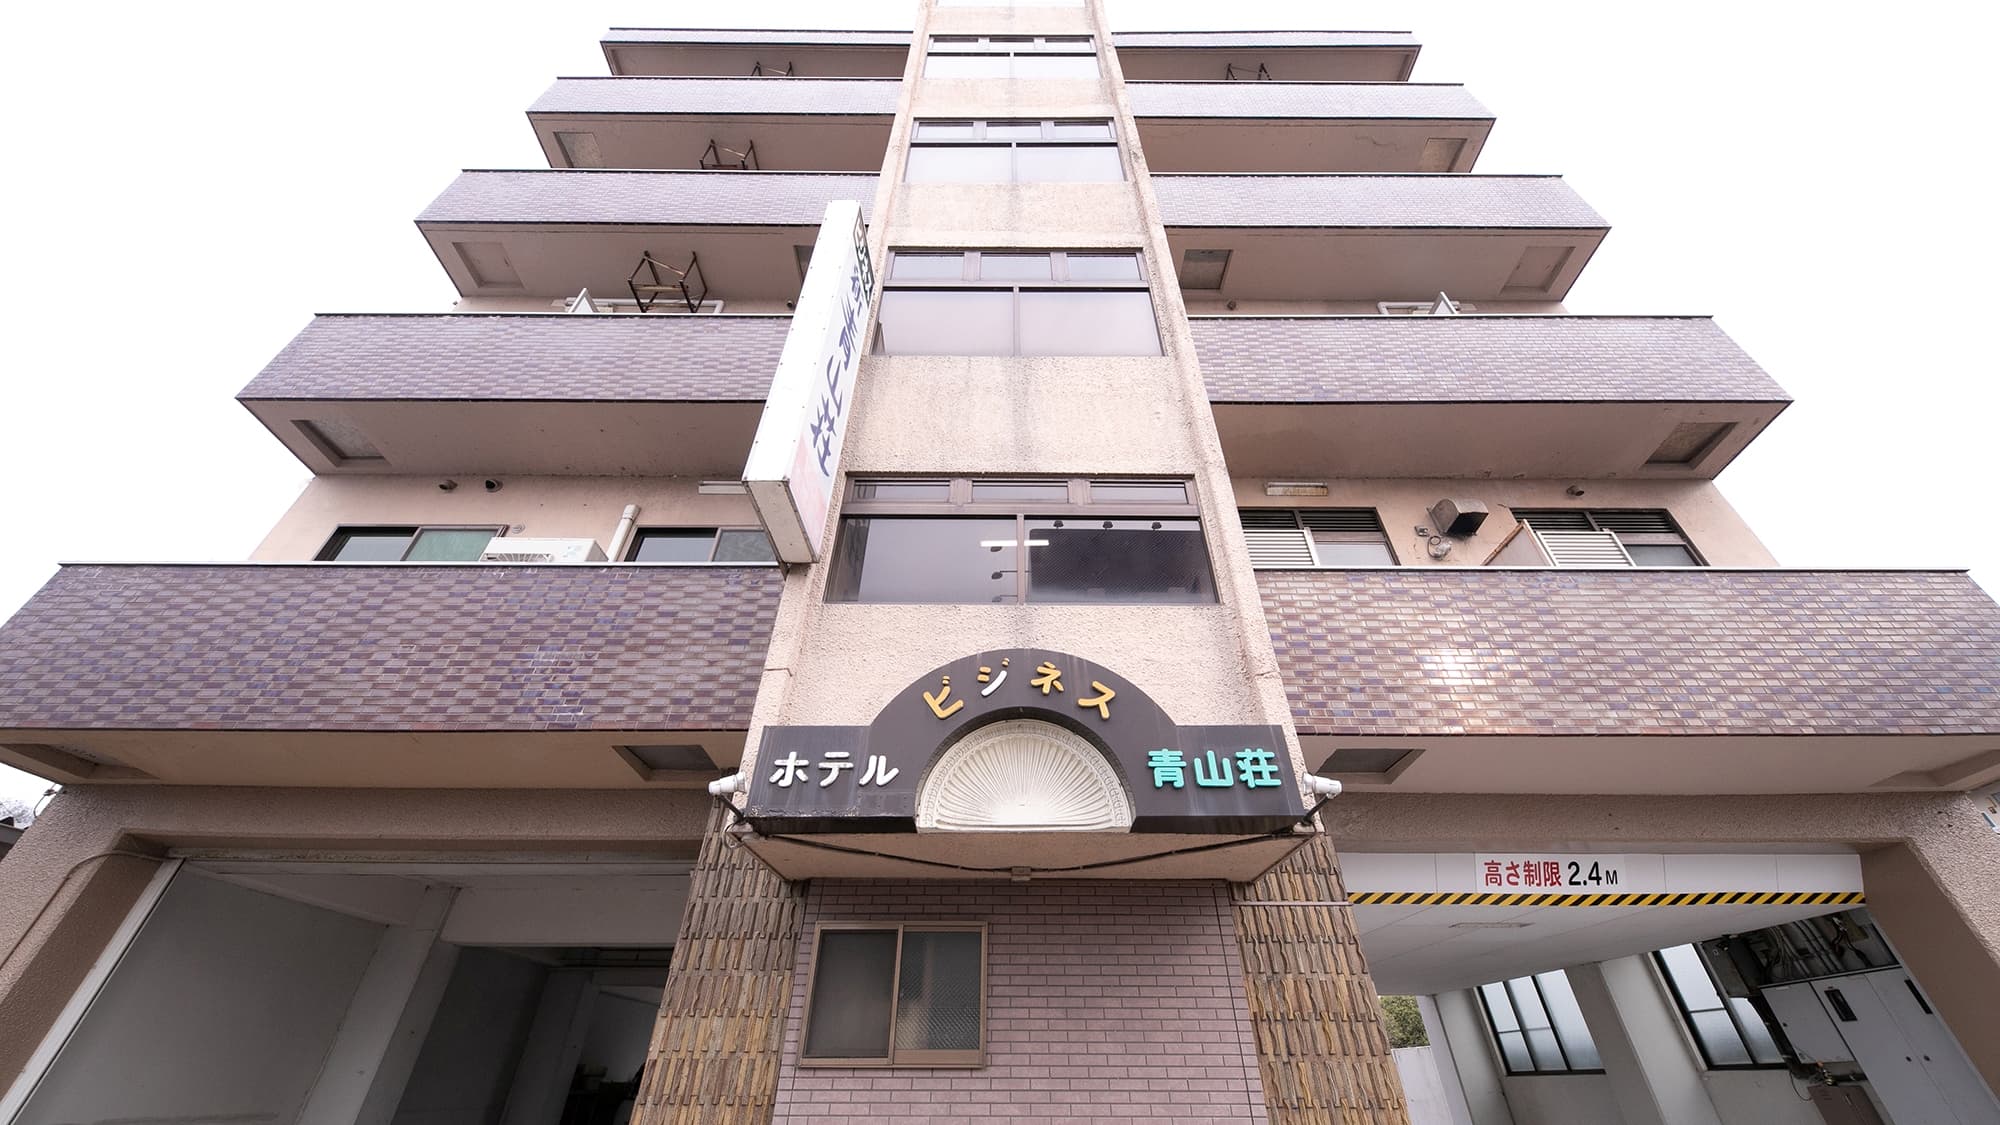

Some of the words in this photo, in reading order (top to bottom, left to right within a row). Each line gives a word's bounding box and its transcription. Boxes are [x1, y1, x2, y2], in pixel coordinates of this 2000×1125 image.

[922, 656, 1116, 719] ビジネス
[768, 750, 900, 788] ホテル
[1147, 748, 1282, 789] 青山荘
[1484, 860, 1563, 888] 高さ制限
